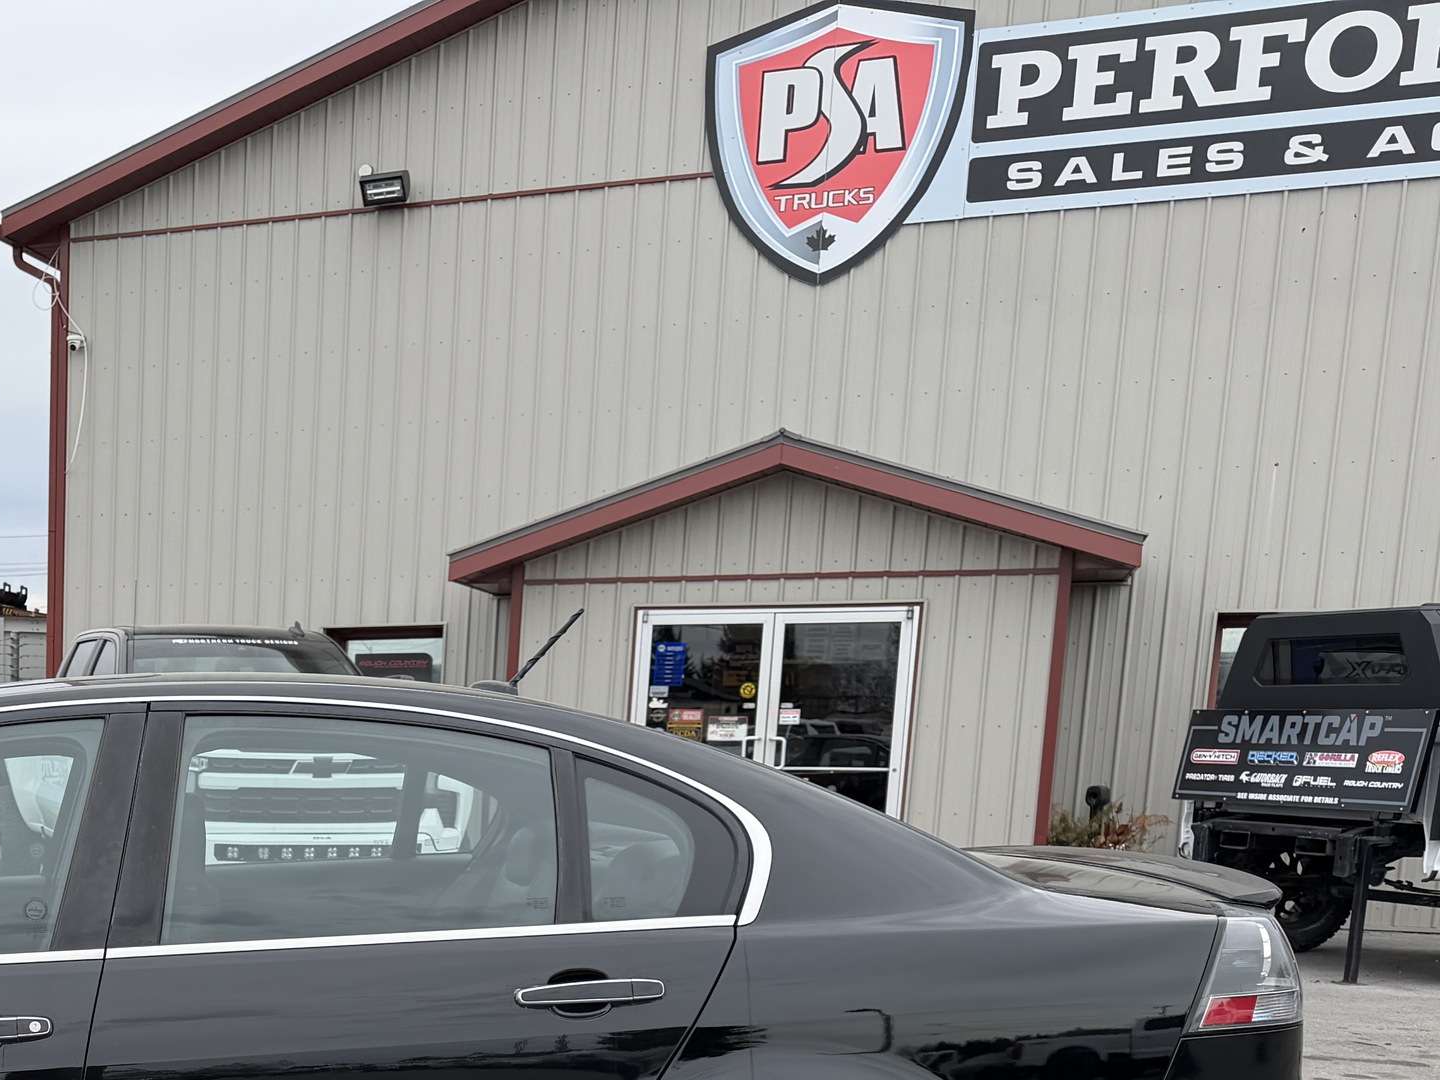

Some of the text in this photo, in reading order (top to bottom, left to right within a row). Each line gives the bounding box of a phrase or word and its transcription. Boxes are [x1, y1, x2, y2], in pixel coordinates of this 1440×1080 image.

[756, 39, 906, 190] PSA
[1006, 121, 1440, 190] SALES & A
[774, 187, 876, 213] TRUCKS
[1217, 714, 1384, 746] SMARTCAP
